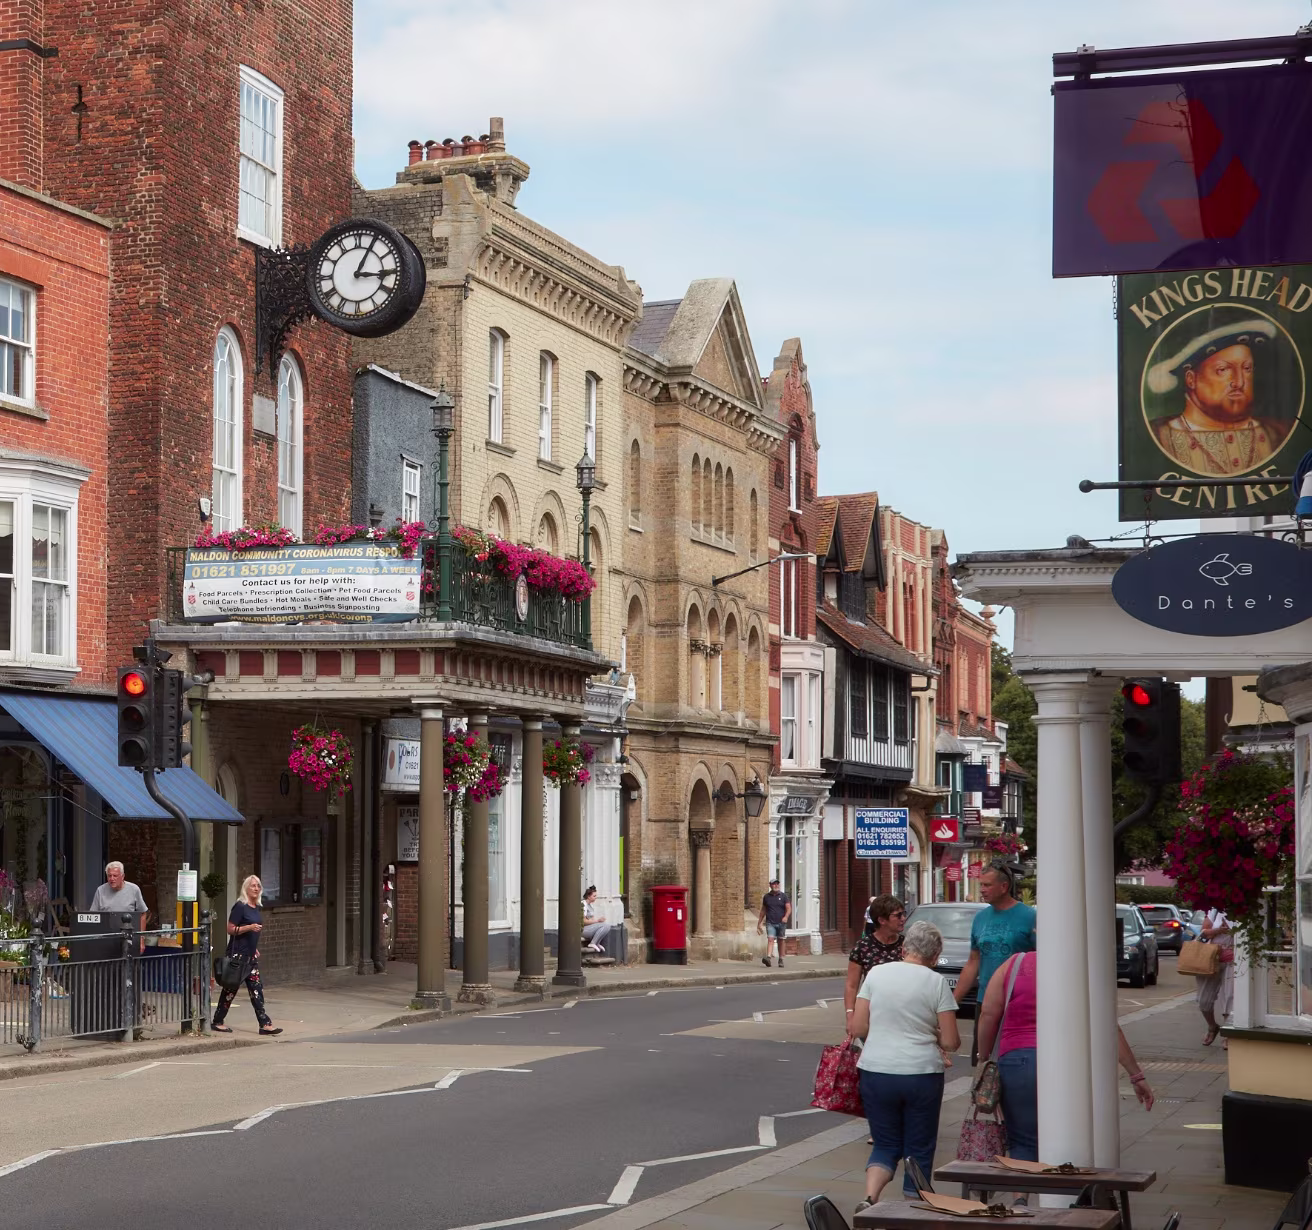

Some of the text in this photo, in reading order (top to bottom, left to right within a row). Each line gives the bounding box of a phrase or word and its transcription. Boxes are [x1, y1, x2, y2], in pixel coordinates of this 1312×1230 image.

[1129, 268, 1312, 329] KINGS HEAD
[1155, 465, 1290, 509] CENTRE
[190, 546, 418, 562] MALDON COMMUNITY CORONAVIRUS RESPOE
[192, 565, 235, 578] 01621
[240, 563, 296, 576] 851997
[327, 566, 346, 575] 8pm
[242, 579, 277, 587] Contact
[309, 577, 329, 586] help
[1158, 595, 1294, 610] Dante's
[788, 798, 808, 809] IMAGE
